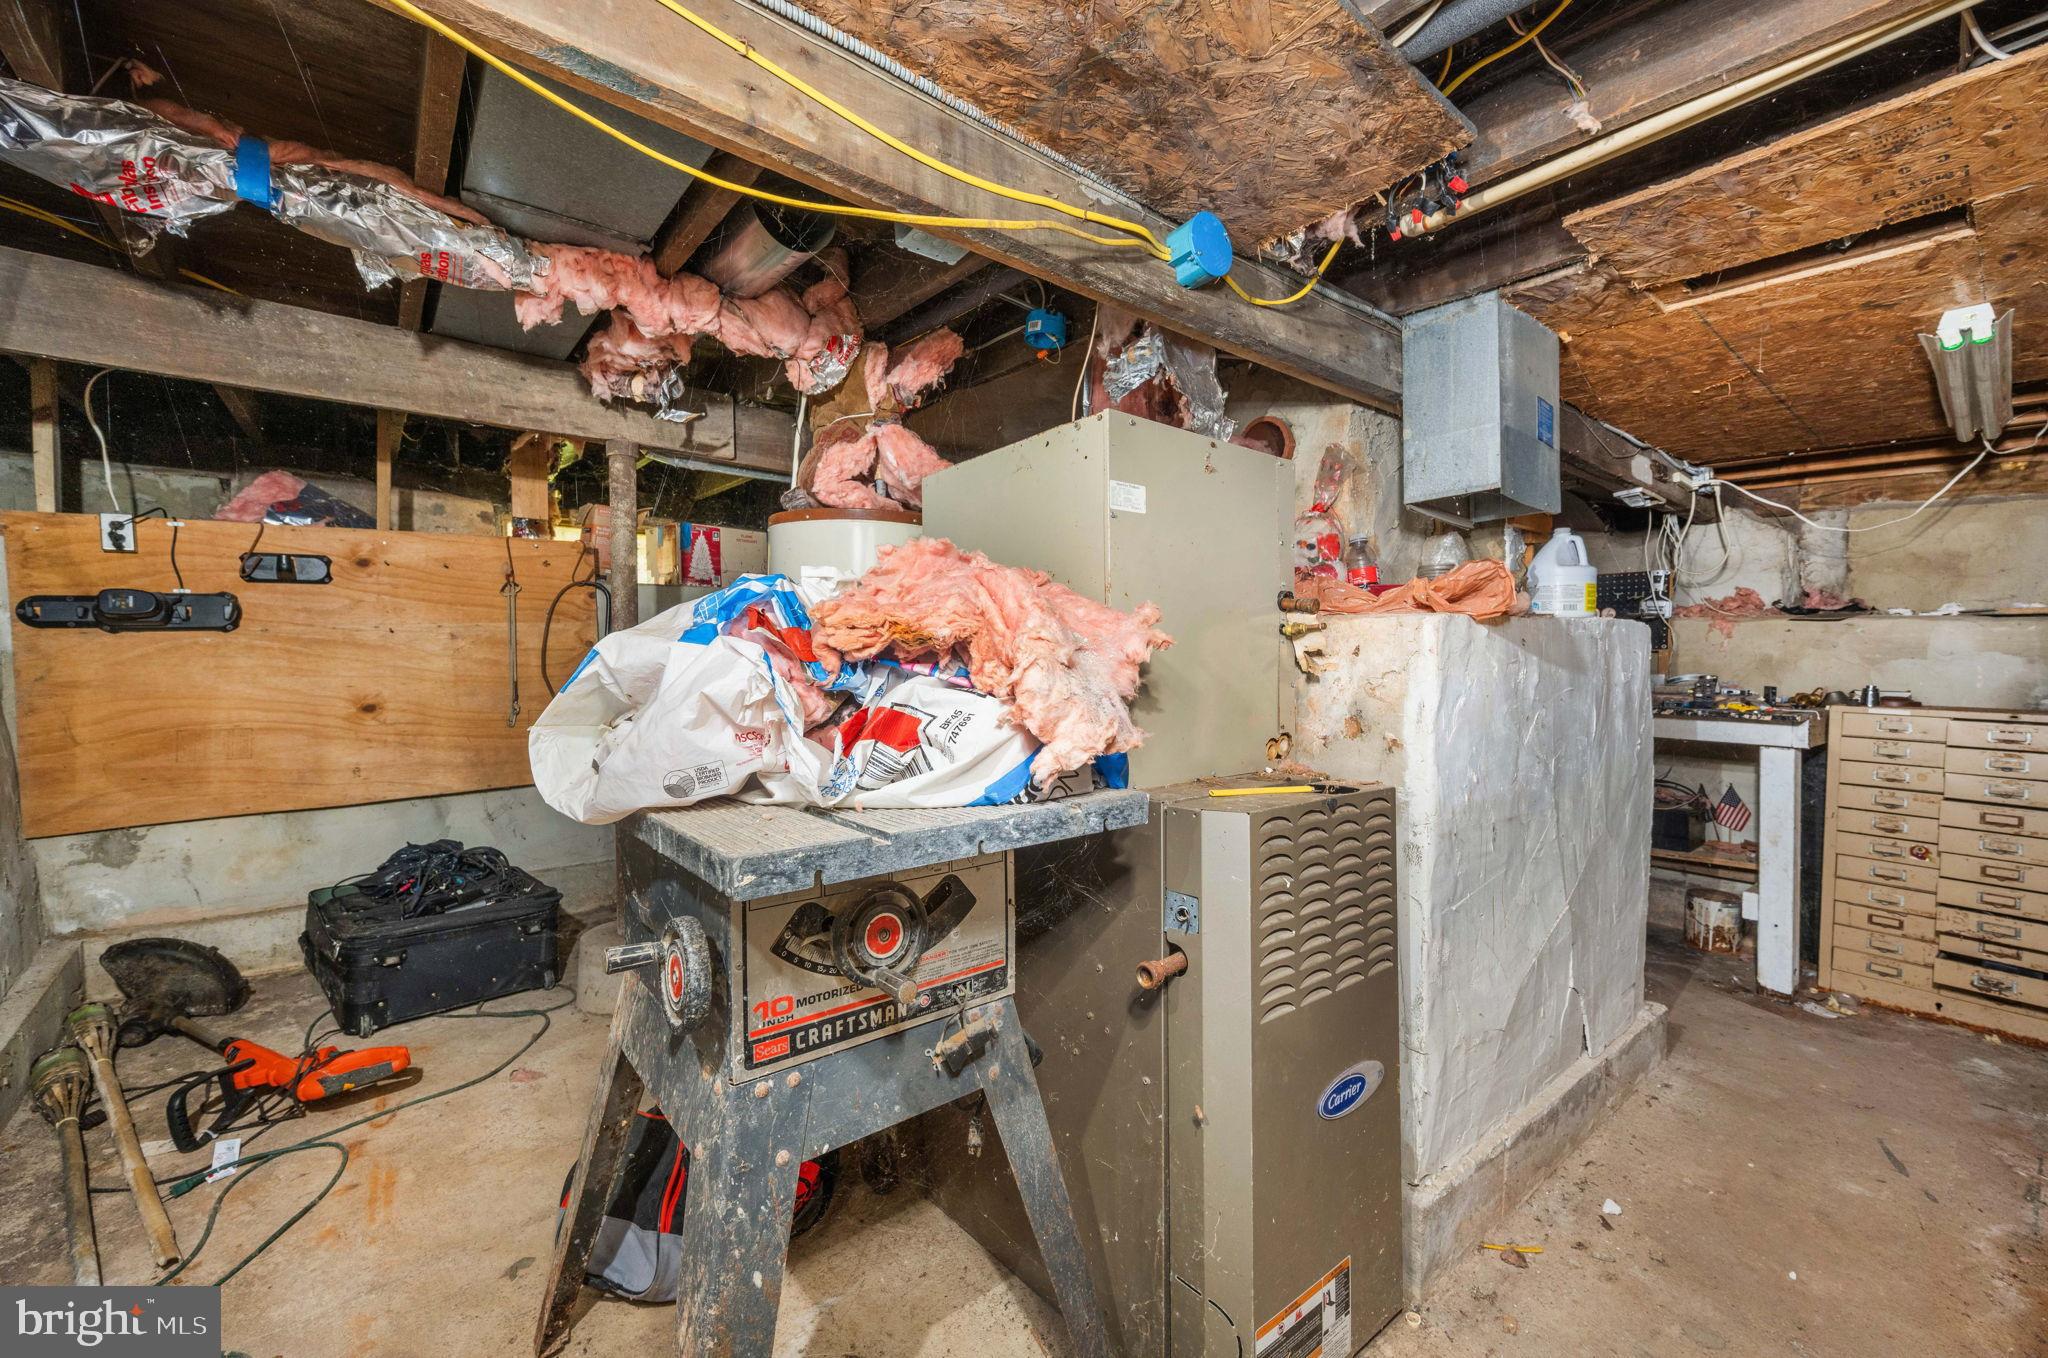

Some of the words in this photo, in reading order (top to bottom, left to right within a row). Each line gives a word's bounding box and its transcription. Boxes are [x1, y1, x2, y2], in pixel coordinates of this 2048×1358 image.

[940, 709, 963, 731] BF45
[948, 713, 975, 744] 747691
[696, 768, 720, 777] CERTIFIED
[697, 772, 721, 781] BIOBASED
[698, 776, 722, 785] PRODUCT
[752, 994, 794, 1020] 10
[796, 984, 864, 1008] MOTORIZED
[756, 1041, 788, 1060] Sears
[796, 1002, 908, 1049] CRAFTSMAN
[762, 1013, 794, 1028] INCH
[1328, 1082, 1361, 1109] Carrier
